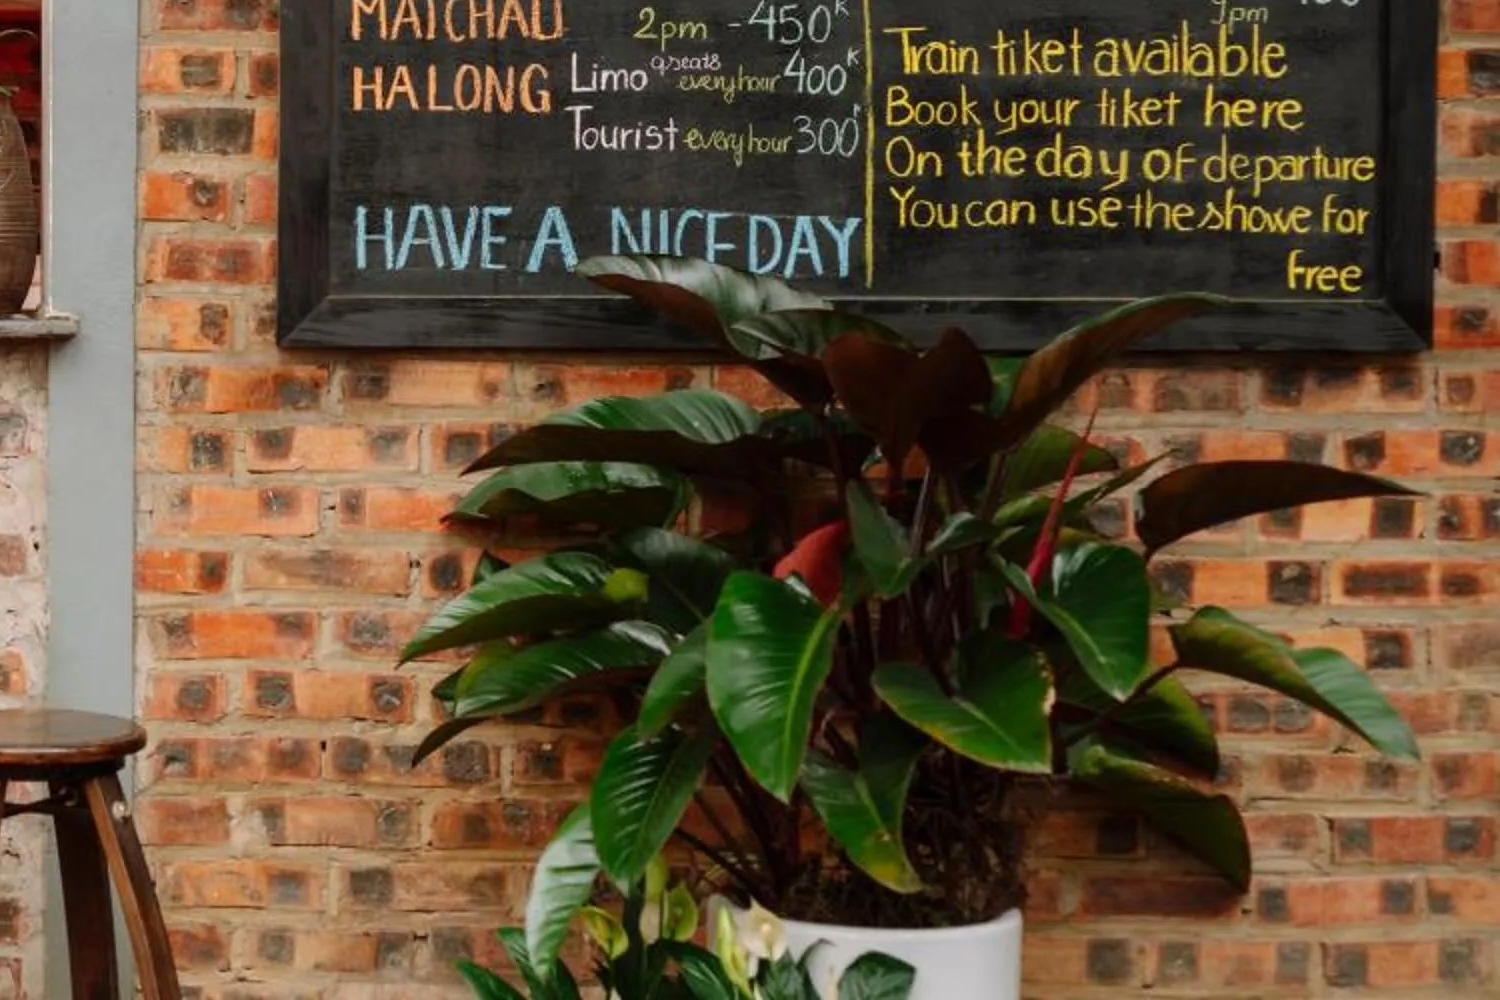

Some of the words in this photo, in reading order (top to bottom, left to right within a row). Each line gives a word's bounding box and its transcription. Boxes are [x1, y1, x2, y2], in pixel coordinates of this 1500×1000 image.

[633, 6, 709, 51] 2pm
[882, 25, 981, 76] Train
[987, 26, 1084, 77] tiket
[1092, 19, 1289, 79] available
[571, 51, 650, 93] Limo
[564, 104, 680, 153] Tourist
[885, 83, 982, 128] Book
[993, 97, 1082, 136] your
[1095, 86, 1183, 128] tiket
[1202, 82, 1305, 131] here
[884, 135, 944, 178] On
[957, 127, 1028, 177] the
[1034, 130, 1130, 192] day
[1141, 141, 1198, 184] of
[1202, 132, 1376, 199] departure
[888, 185, 959, 229] You
[964, 198, 1037, 228] can
[1050, 196, 1123, 228] use
[1127, 189, 1197, 232] the
[1321, 192, 1372, 236] for
[355, 204, 514, 273] HAVE
[525, 204, 579, 274] A
[610, 206, 737, 264] NICE
[748, 213, 863, 280] DAY
[1287, 248, 1364, 294] free
